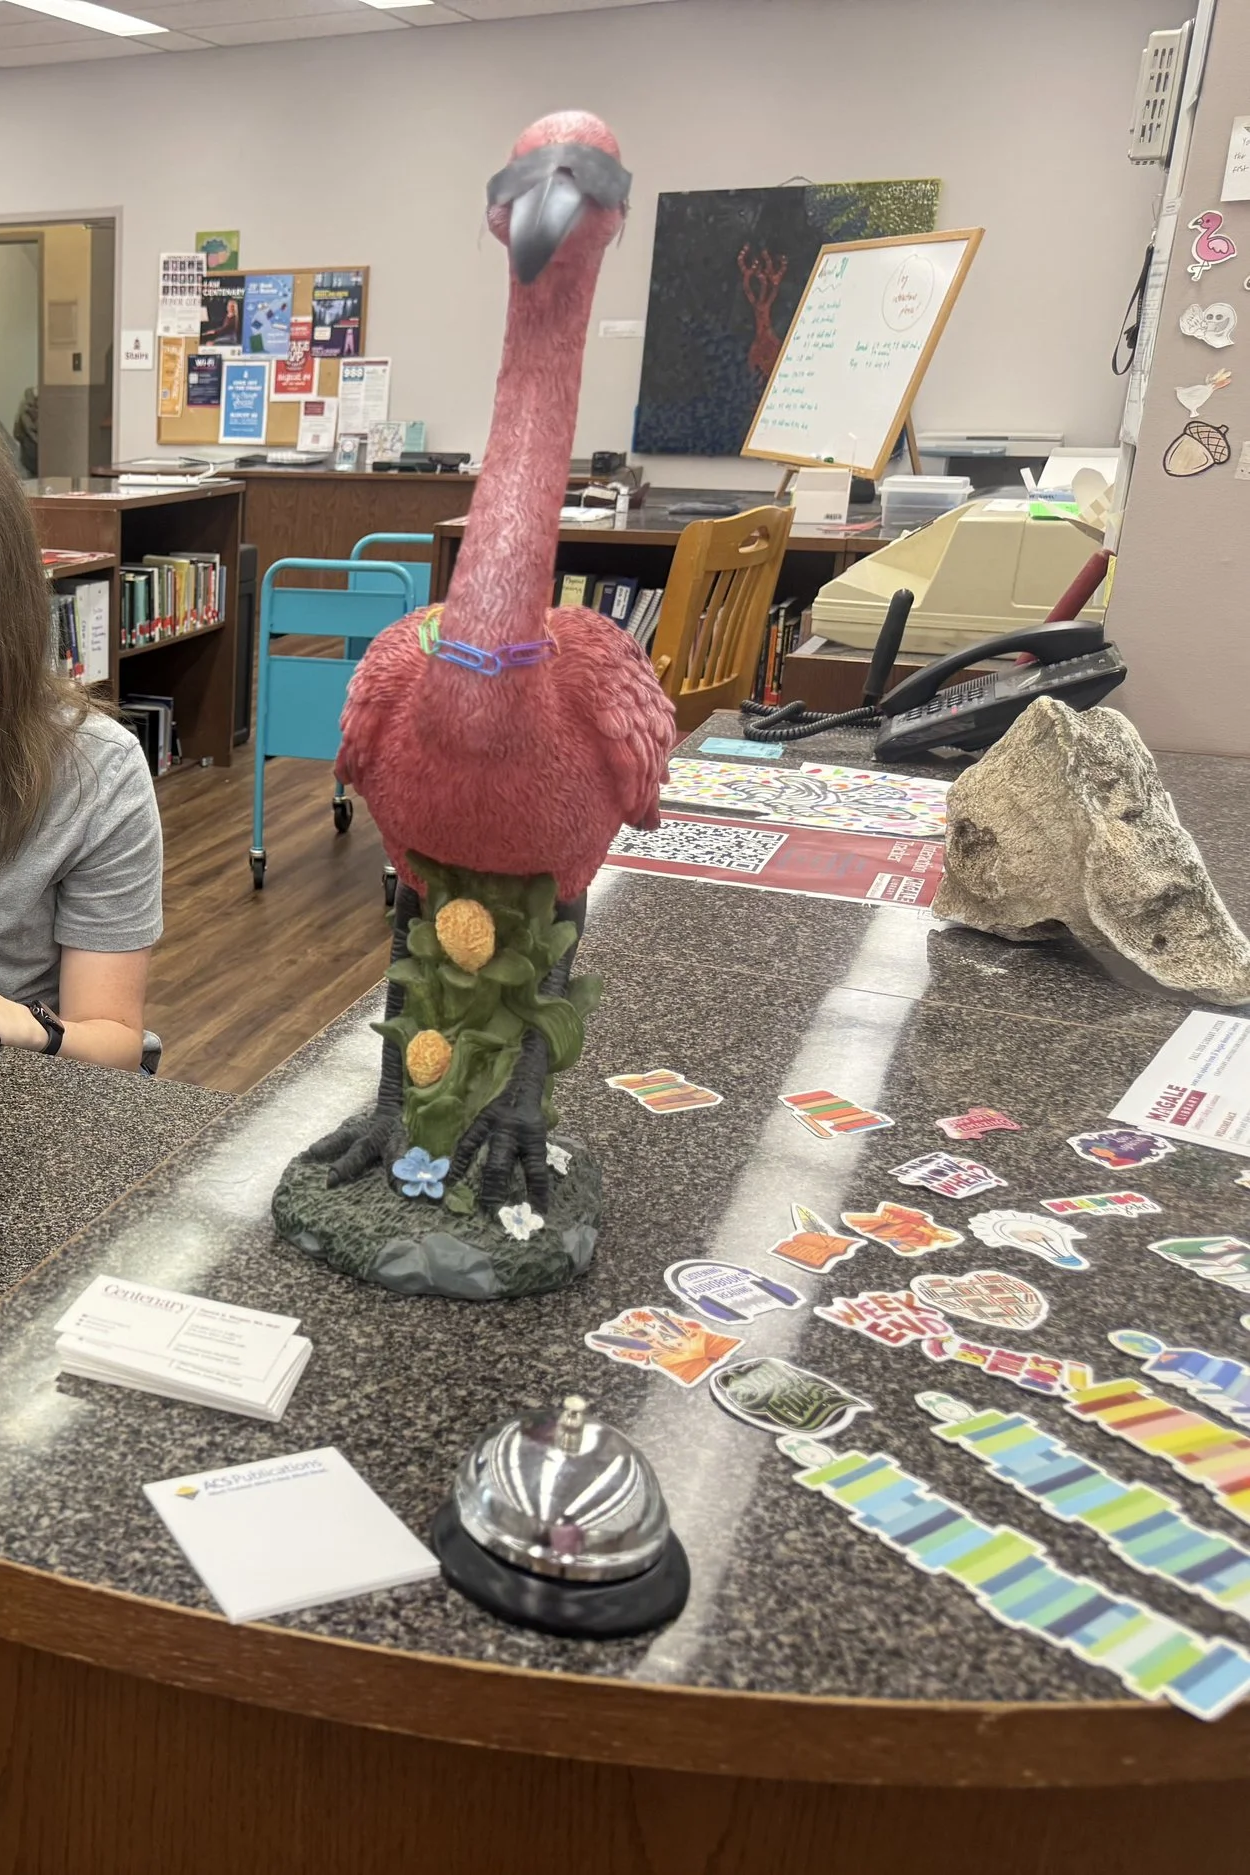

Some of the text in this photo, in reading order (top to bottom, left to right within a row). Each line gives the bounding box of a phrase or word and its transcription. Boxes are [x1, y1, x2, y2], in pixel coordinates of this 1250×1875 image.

[203, 287, 245, 297] CENTENARY
[124, 352, 149, 360] Stairs
[1145, 1084, 1188, 1122] MAGALE
[1177, 1096, 1200, 1120] LIBRARY
[909, 1153, 942, 1170] NOT
[919, 1158, 968, 1185] NOW
[930, 1164, 1002, 1196] WHEN?
[1046, 1193, 1145, 1212] READING
[682, 1266, 722, 1281] LISTENING
[689, 1273, 751, 1294] AUDIOBOOKS
[103, 1283, 190, 1315] Centenary
[717, 1286, 753, 1299] READING
[823, 1291, 937, 1326] WEEK
[864, 1314, 949, 1344] END
[985, 1349, 1028, 1377] THE
[204, 1458, 324, 1490] ACS Publications
